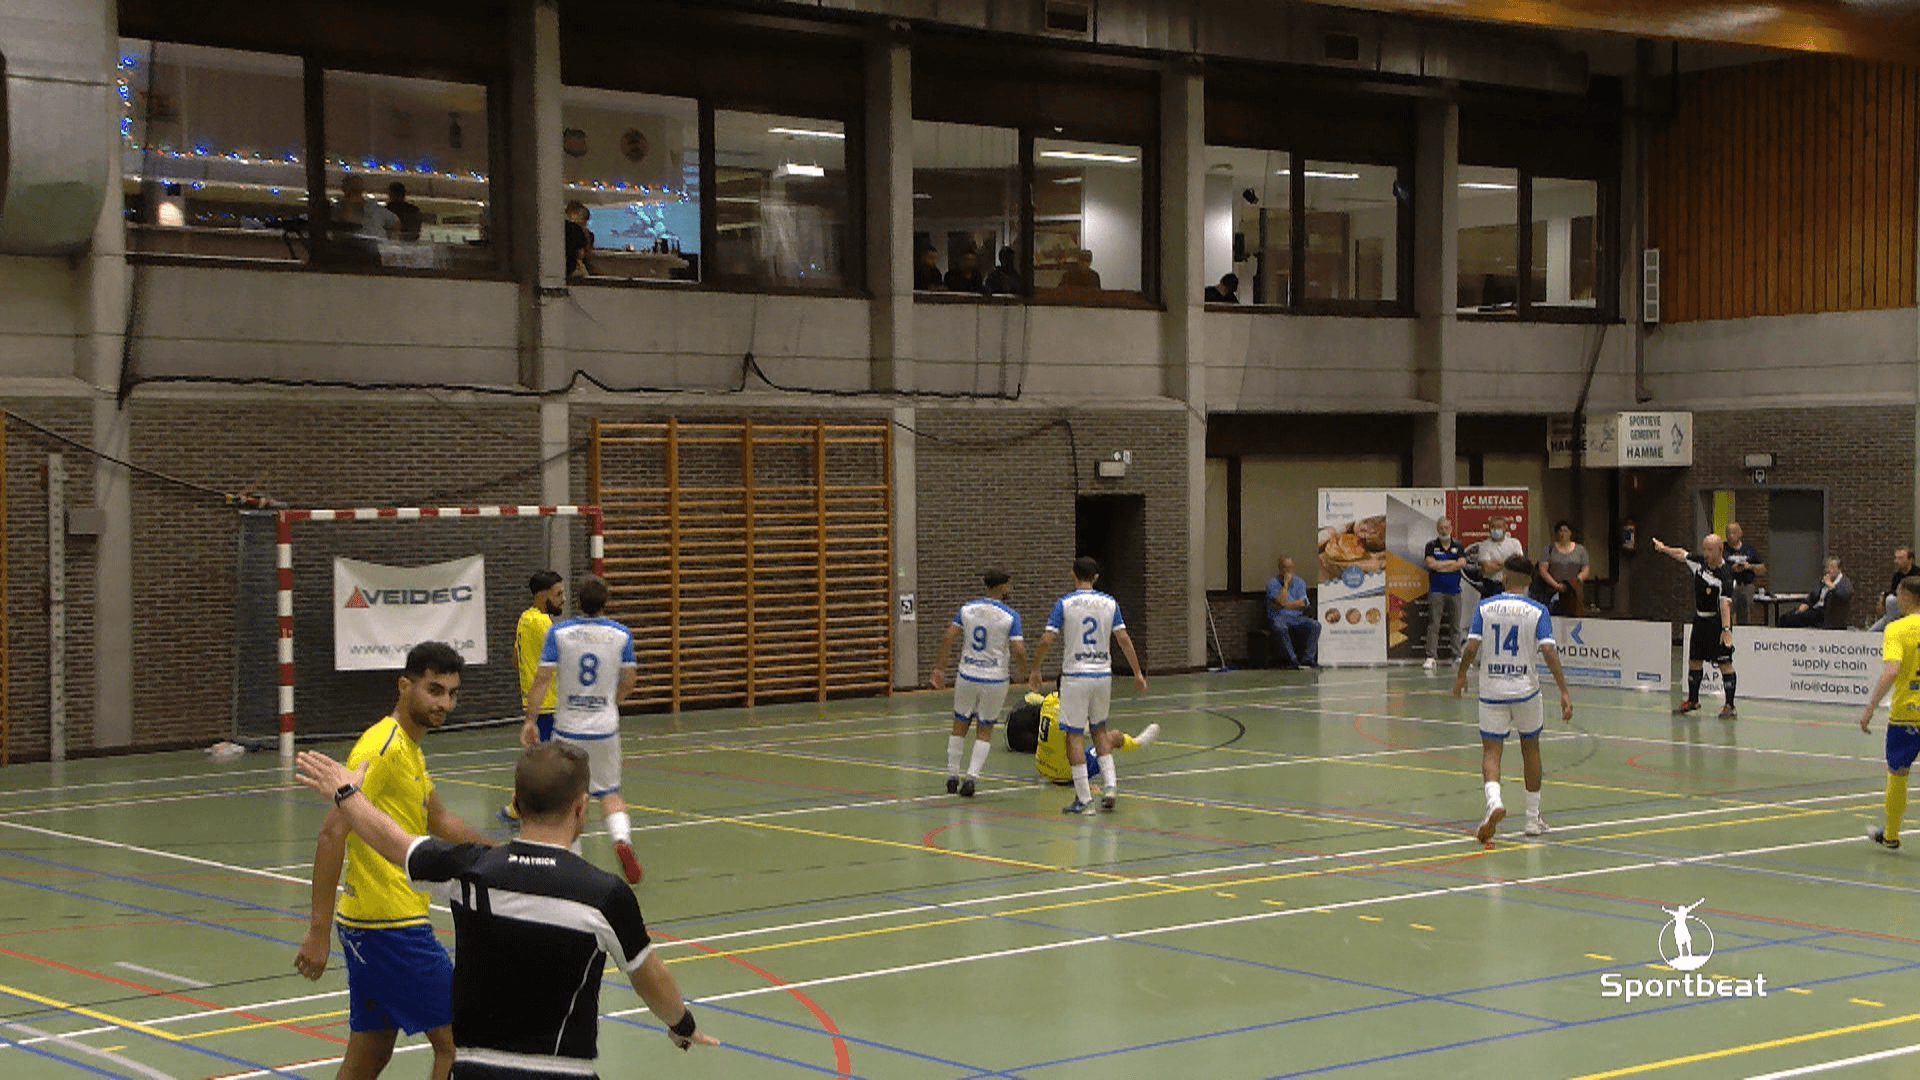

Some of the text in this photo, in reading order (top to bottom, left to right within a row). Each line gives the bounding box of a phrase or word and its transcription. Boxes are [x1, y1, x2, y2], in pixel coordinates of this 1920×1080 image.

[1629, 416, 1661, 426] SPORTIEVE
[1630, 429, 1661, 440] GEMEENTE
[1626, 446, 1664, 458] HAMME
[1462, 496, 1523, 505] AC METALEC
[362, 585, 473, 605] VEIDEC
[1082, 616, 1098, 645] 2
[971, 626, 988, 652] 9
[1491, 623, 1519, 657] 14
[1754, 640, 1885, 656] purchase subcontrac
[579, 653, 598, 686] 8
[1792, 658, 1867, 671] supply chain
[1790, 680, 1869, 695] info@daps.be
[518, 855, 557, 867] PATRICK
